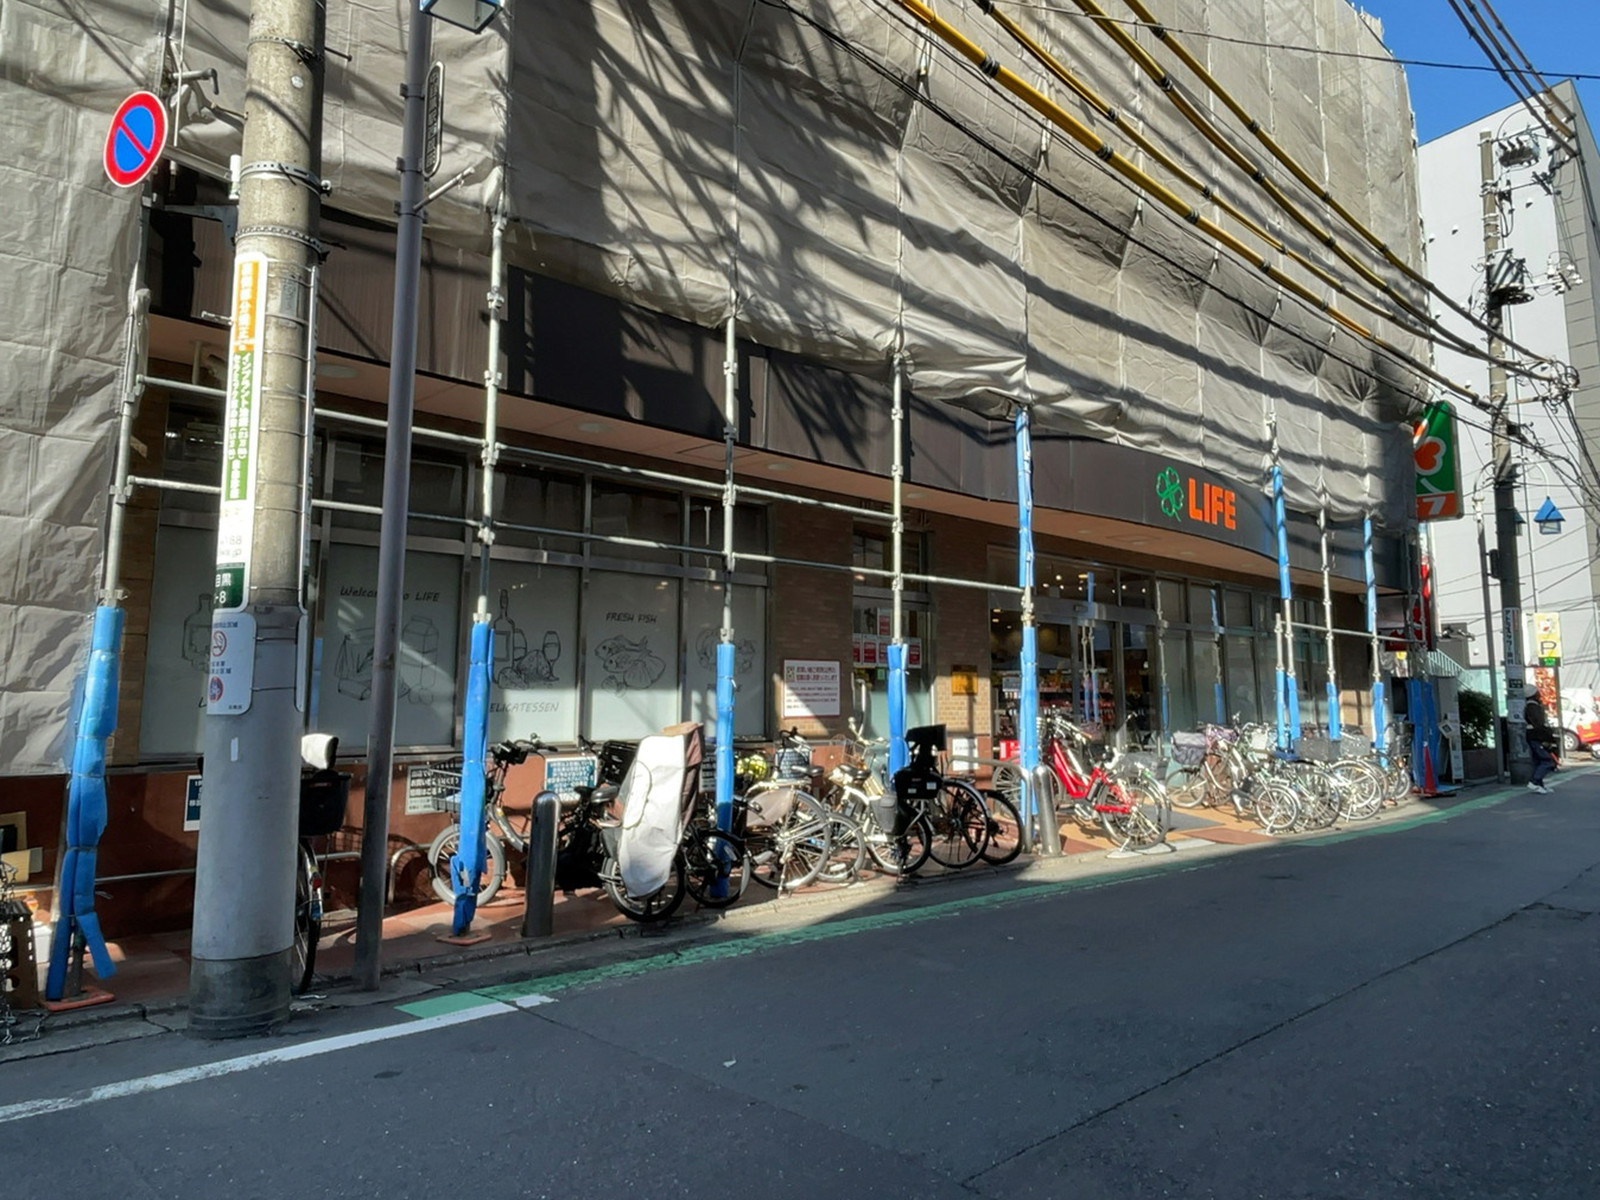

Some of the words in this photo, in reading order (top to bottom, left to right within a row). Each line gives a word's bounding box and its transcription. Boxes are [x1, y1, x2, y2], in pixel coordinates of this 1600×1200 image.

[1188, 477, 1236, 531] LIFE
[416, 590, 440, 602] LIFE
[605, 612, 634, 622] FRESH
[1540, 640, 1557, 655] P
[489, 702, 560, 714] ELICATESSEN
